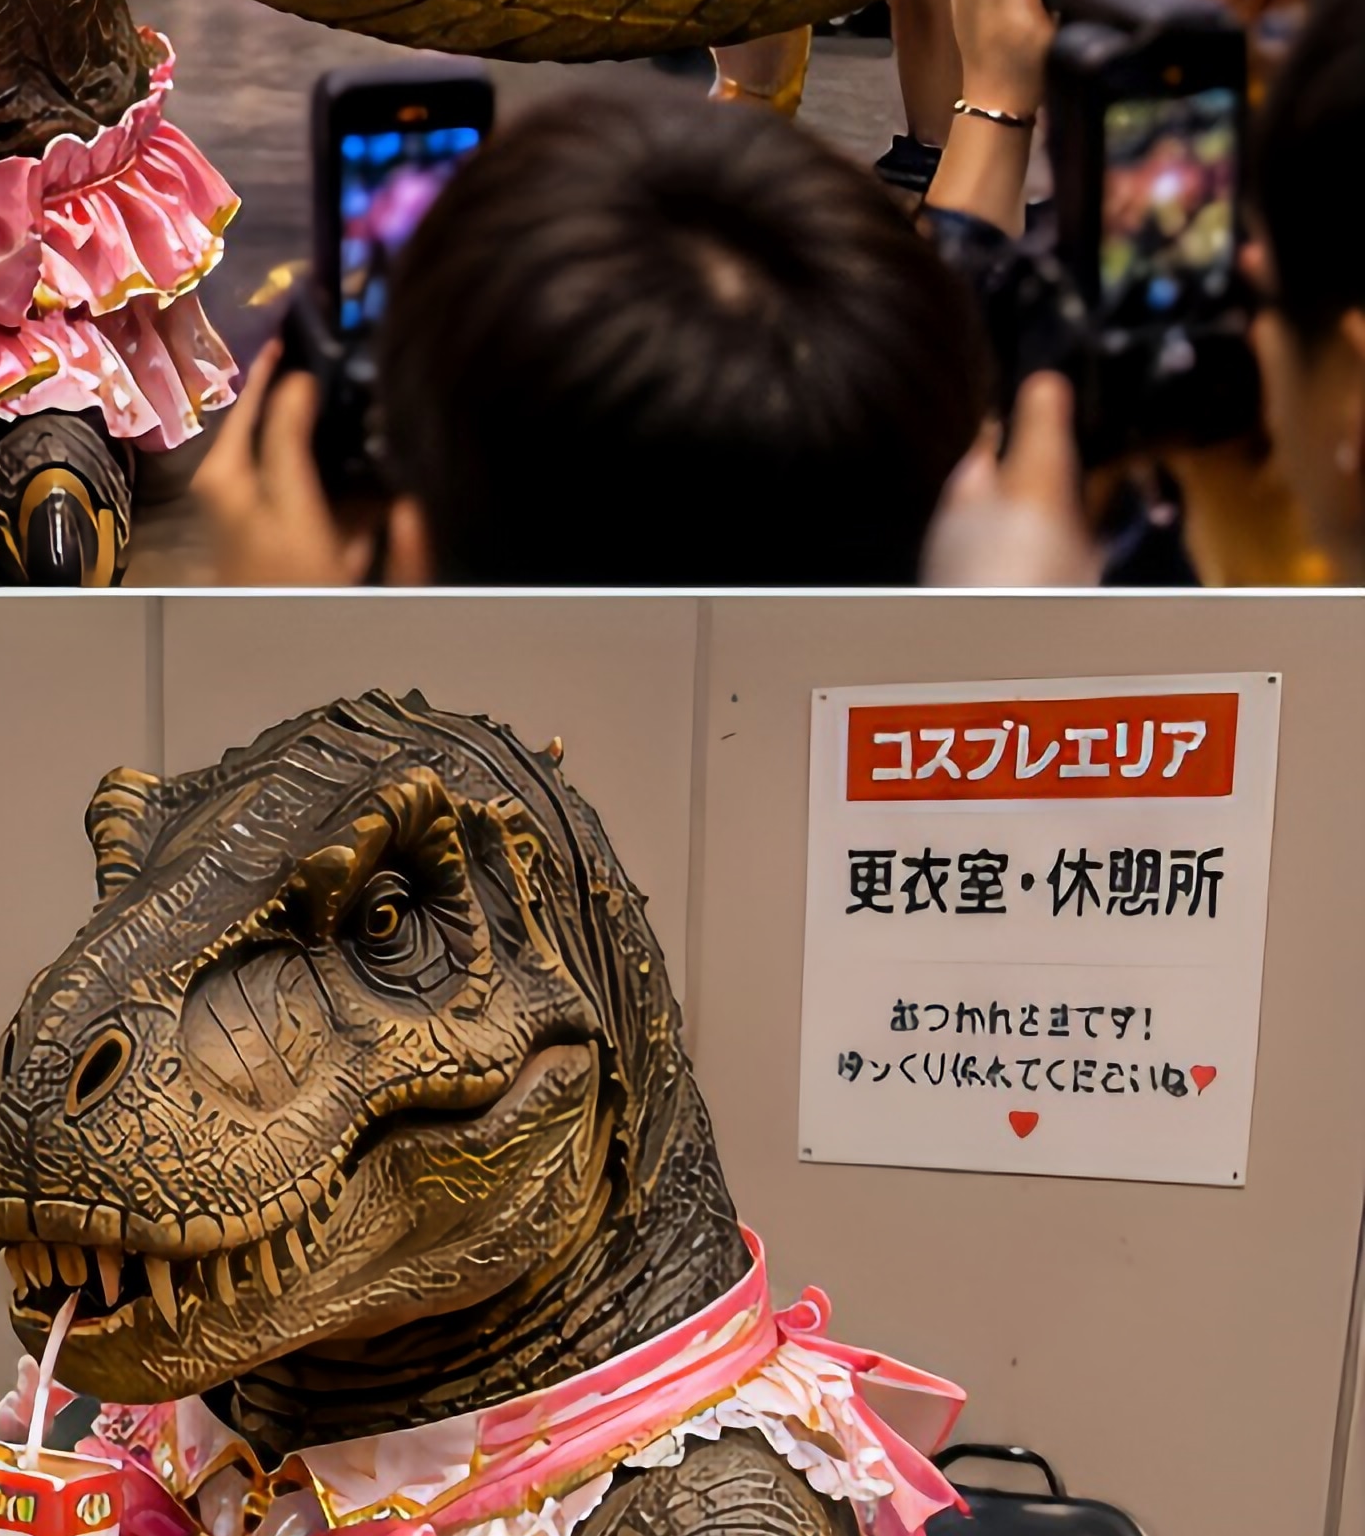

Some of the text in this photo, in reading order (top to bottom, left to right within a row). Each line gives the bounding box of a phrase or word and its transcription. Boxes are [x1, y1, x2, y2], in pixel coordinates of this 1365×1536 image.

[872, 719, 1207, 782] コスプレエリア
